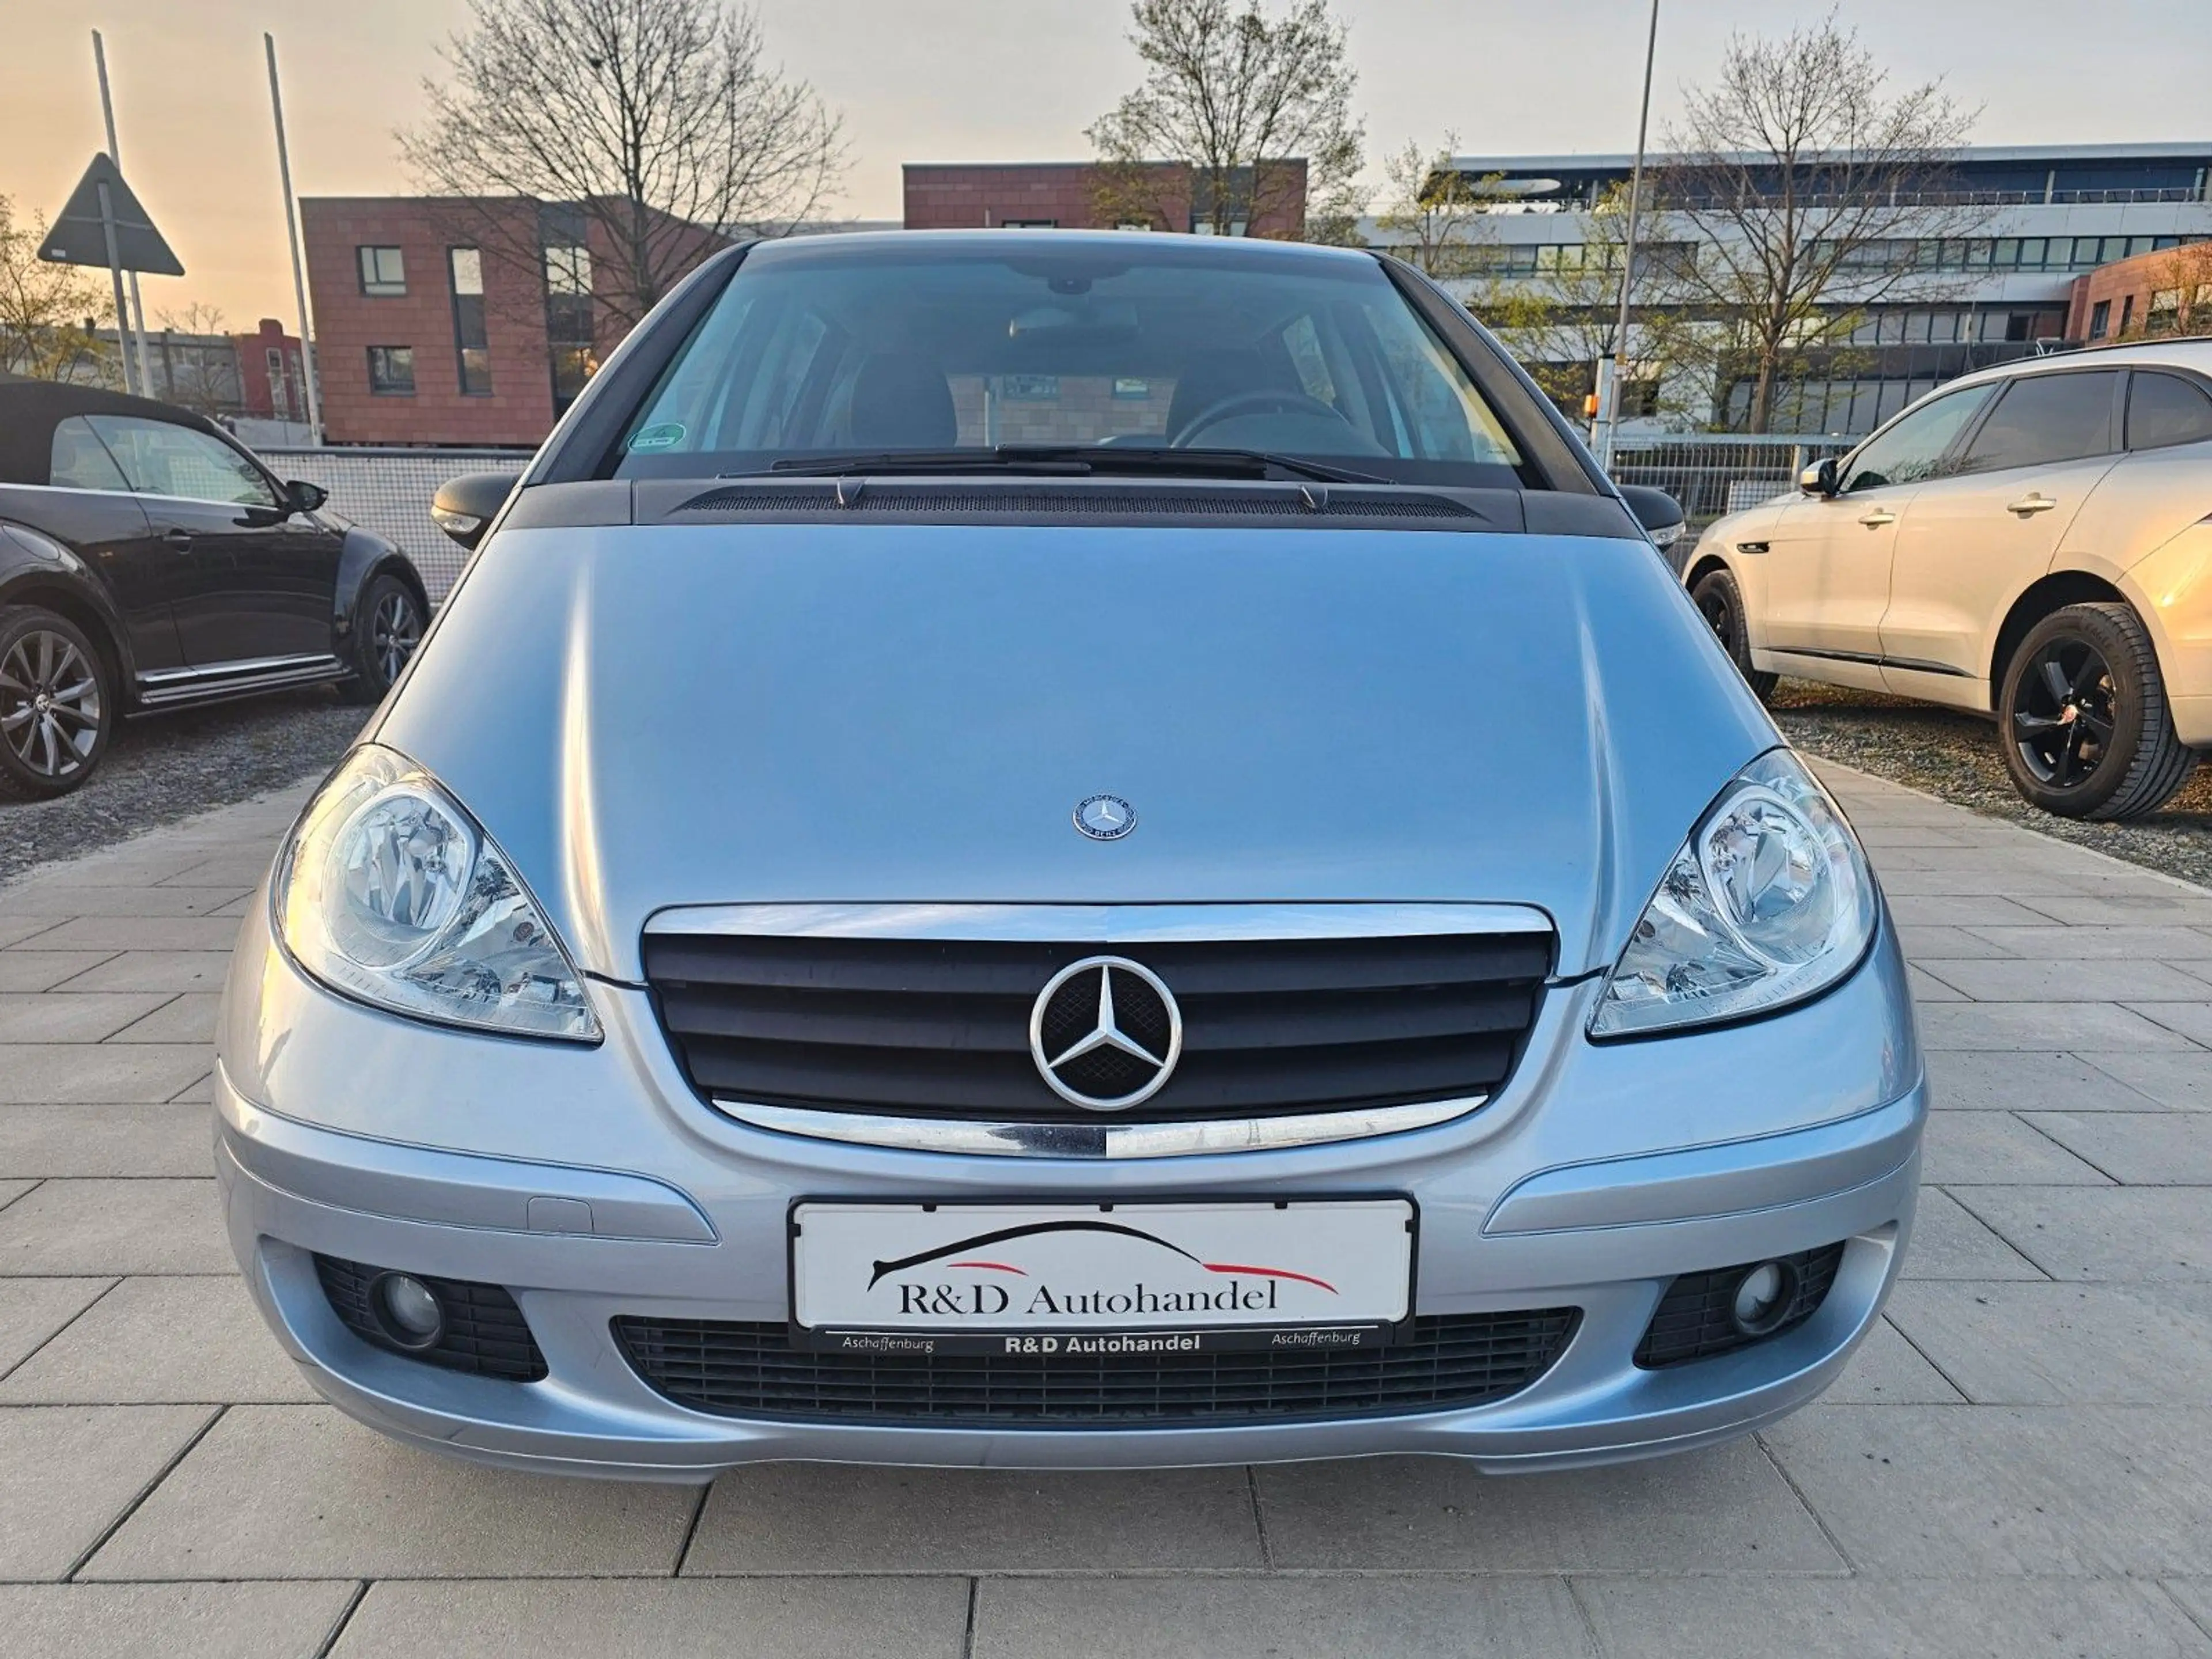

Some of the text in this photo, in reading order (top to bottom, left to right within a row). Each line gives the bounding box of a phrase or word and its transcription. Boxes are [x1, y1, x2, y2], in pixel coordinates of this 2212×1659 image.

[897, 1280, 1278, 1315] R&D Autohandel
[842, 1336, 934, 1353] Aschaffenburg
[1005, 1334, 1200, 1353] R&D Autohandel
[1272, 1331, 1361, 1345] Aschaffenburg
